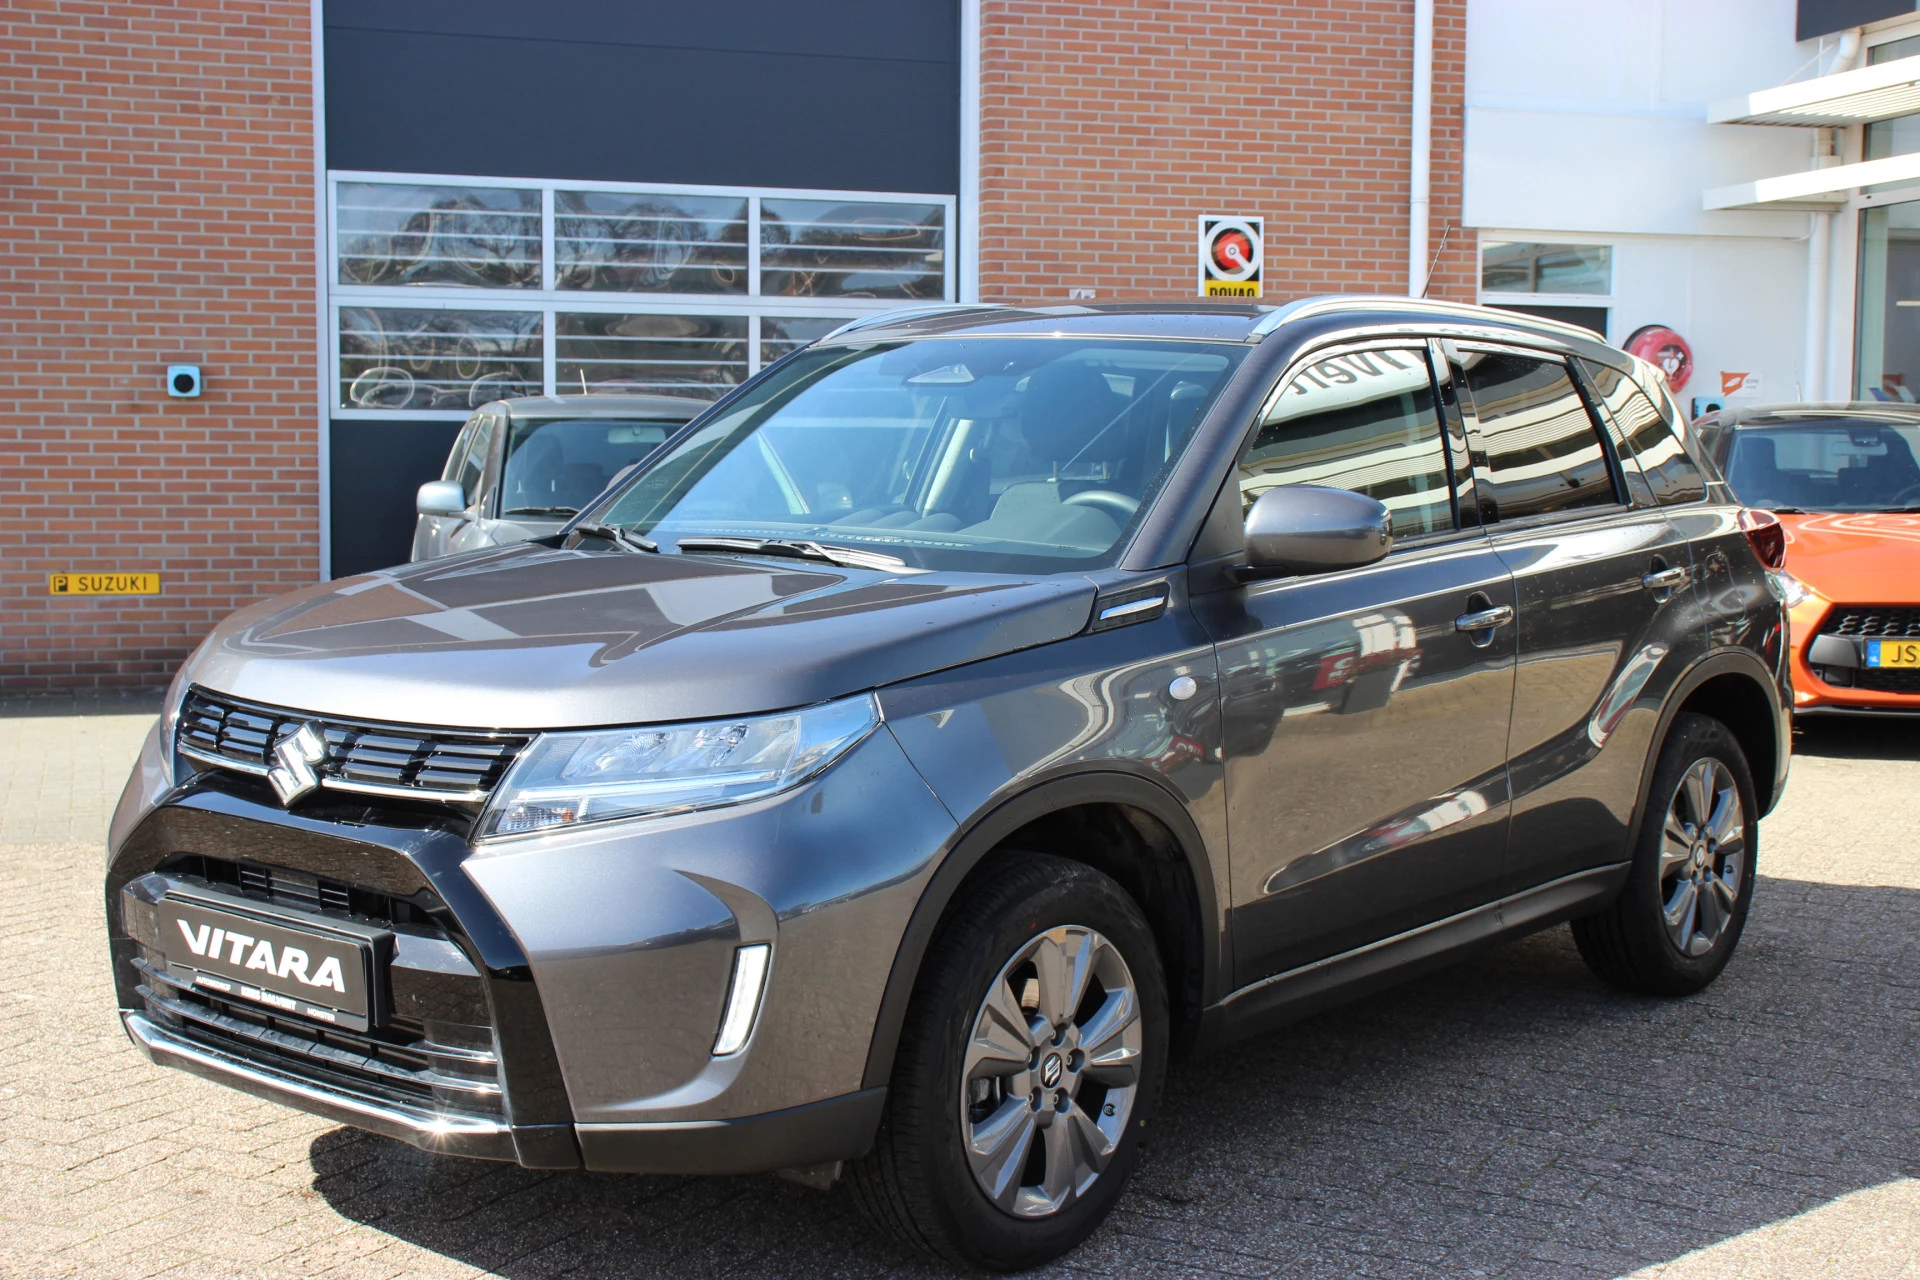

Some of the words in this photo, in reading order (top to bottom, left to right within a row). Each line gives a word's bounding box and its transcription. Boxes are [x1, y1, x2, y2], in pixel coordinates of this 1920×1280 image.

[55, 576, 67, 592] P
[78, 576, 147, 592] SUZUKI
[177, 918, 346, 994] VITARA
[306, 1007, 336, 1022] MONSTER
